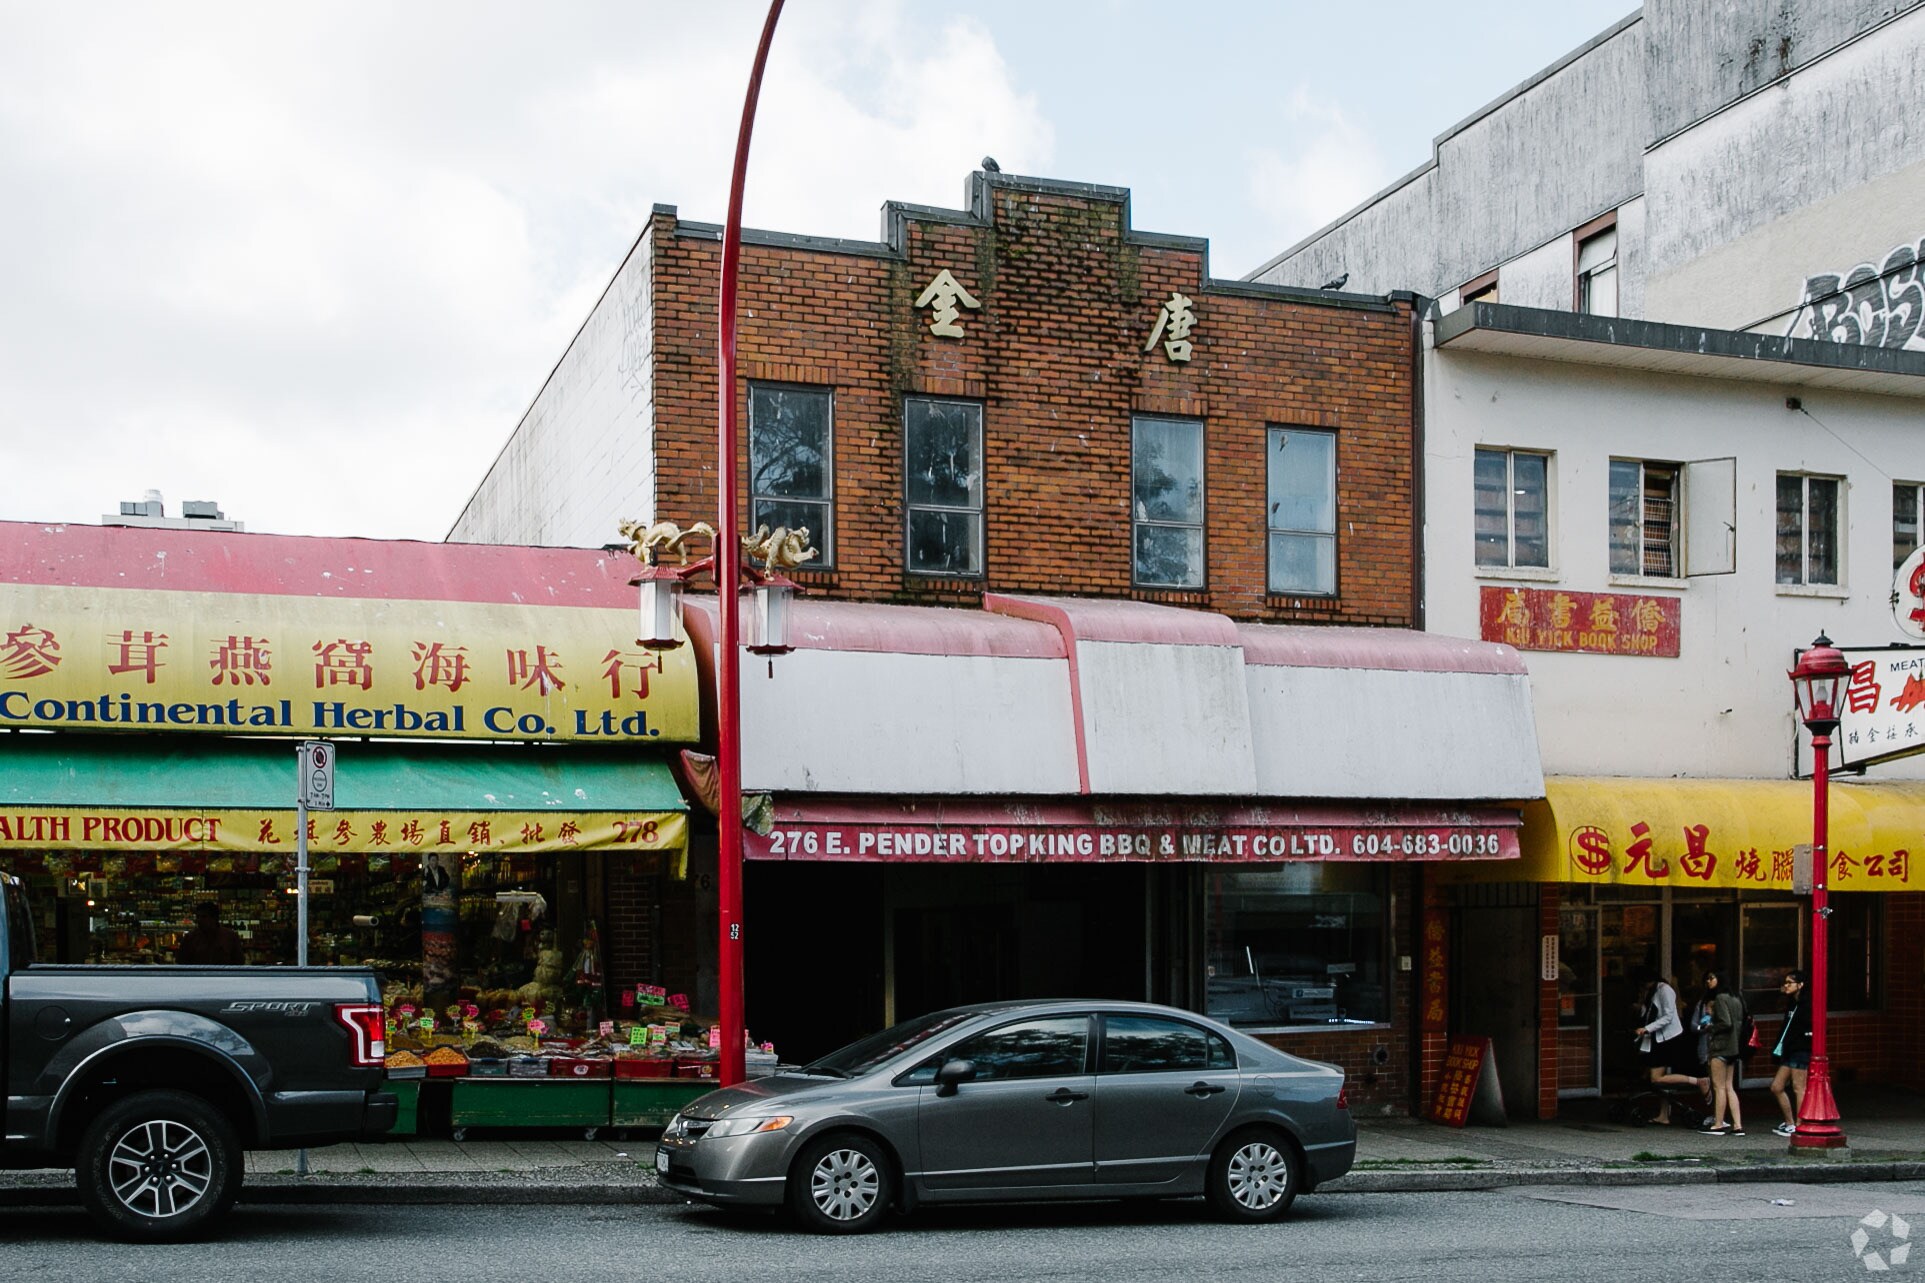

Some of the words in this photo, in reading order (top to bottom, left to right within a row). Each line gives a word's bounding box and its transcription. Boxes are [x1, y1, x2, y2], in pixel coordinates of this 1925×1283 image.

[915, 269, 981, 338] 金
[1145, 292, 1197, 362] 唐
[1579, 632, 1617, 649] BOOK
[1621, 634, 1658, 650] SHOP
[0, 691, 294, 728] Continental
[312, 701, 467, 731] Herbal
[484, 706, 556, 734] Co.
[574, 709, 661, 737] Ltd.
[0, 816, 71, 841] ALTH
[82, 816, 222, 842] PRODUCT
[611, 821, 660, 844] 278
[769, 831, 818, 854] 276
[825, 832, 851, 855] E.
[858, 833, 967, 856] PENDER
[1099, 834, 1151, 857] BBQ
[1158, 834, 1175, 855] &
[1182, 834, 1248, 856] MEAT
[1352, 834, 1500, 855] 604-683-0036
[1623, 821, 1717, 881] 元昌
[730, 923, 740, 932] 12
[220, 1001, 321, 1013] SPORT
